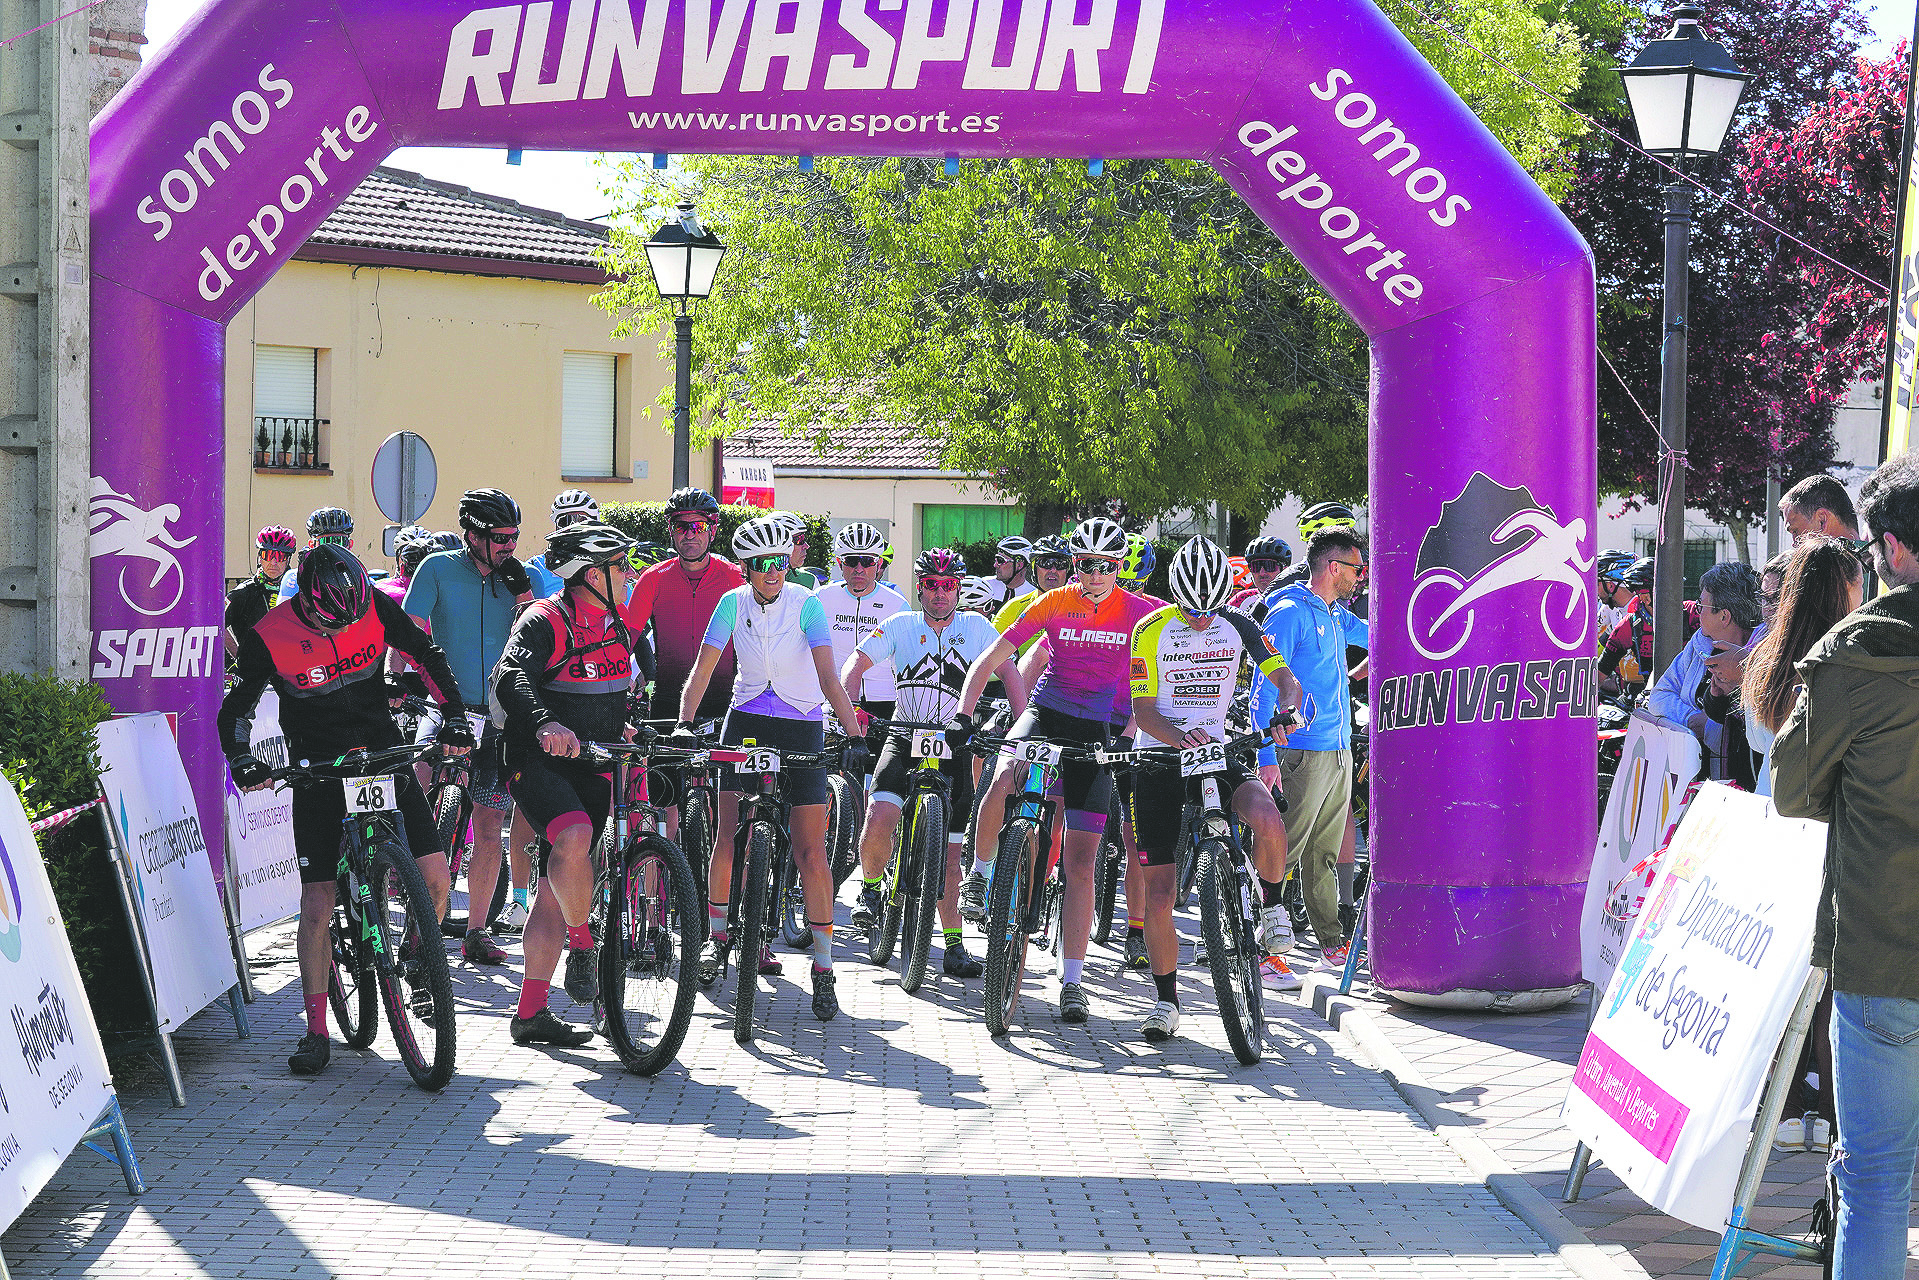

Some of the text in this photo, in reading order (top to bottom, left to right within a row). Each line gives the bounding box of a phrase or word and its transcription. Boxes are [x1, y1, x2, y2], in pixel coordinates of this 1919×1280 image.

[628, 110, 1000, 136] www.runvasport.es
[137, 62, 295, 242] somos
[1309, 67, 1473, 227] somos
[197, 104, 378, 302] deporte
[1238, 119, 1424, 306] deporte
[740, 467, 767, 481] VARGAS
[835, 614, 878, 625] FONTANERÍA
[1058, 627, 1128, 645] OLMEDO
[296, 643, 377, 687] espacio
[568, 656, 632, 681] espaci
[1173, 670, 1224, 681] WANTY
[920, 738, 943, 757] 60
[1025, 744, 1051, 762] 62
[1183, 745, 1222, 767] 236
[744, 755, 771, 771] 45
[355, 786, 385, 811] 48
[1676, 875, 1774, 969] Diputación
[368, 924, 384, 954] FOX
[1636, 953, 1731, 1057] de Segovia
[48, 1083, 62, 1109] DE
[57, 1061, 84, 1102] SEGOVIA
[1627, 1086, 1660, 1132] Deportes
